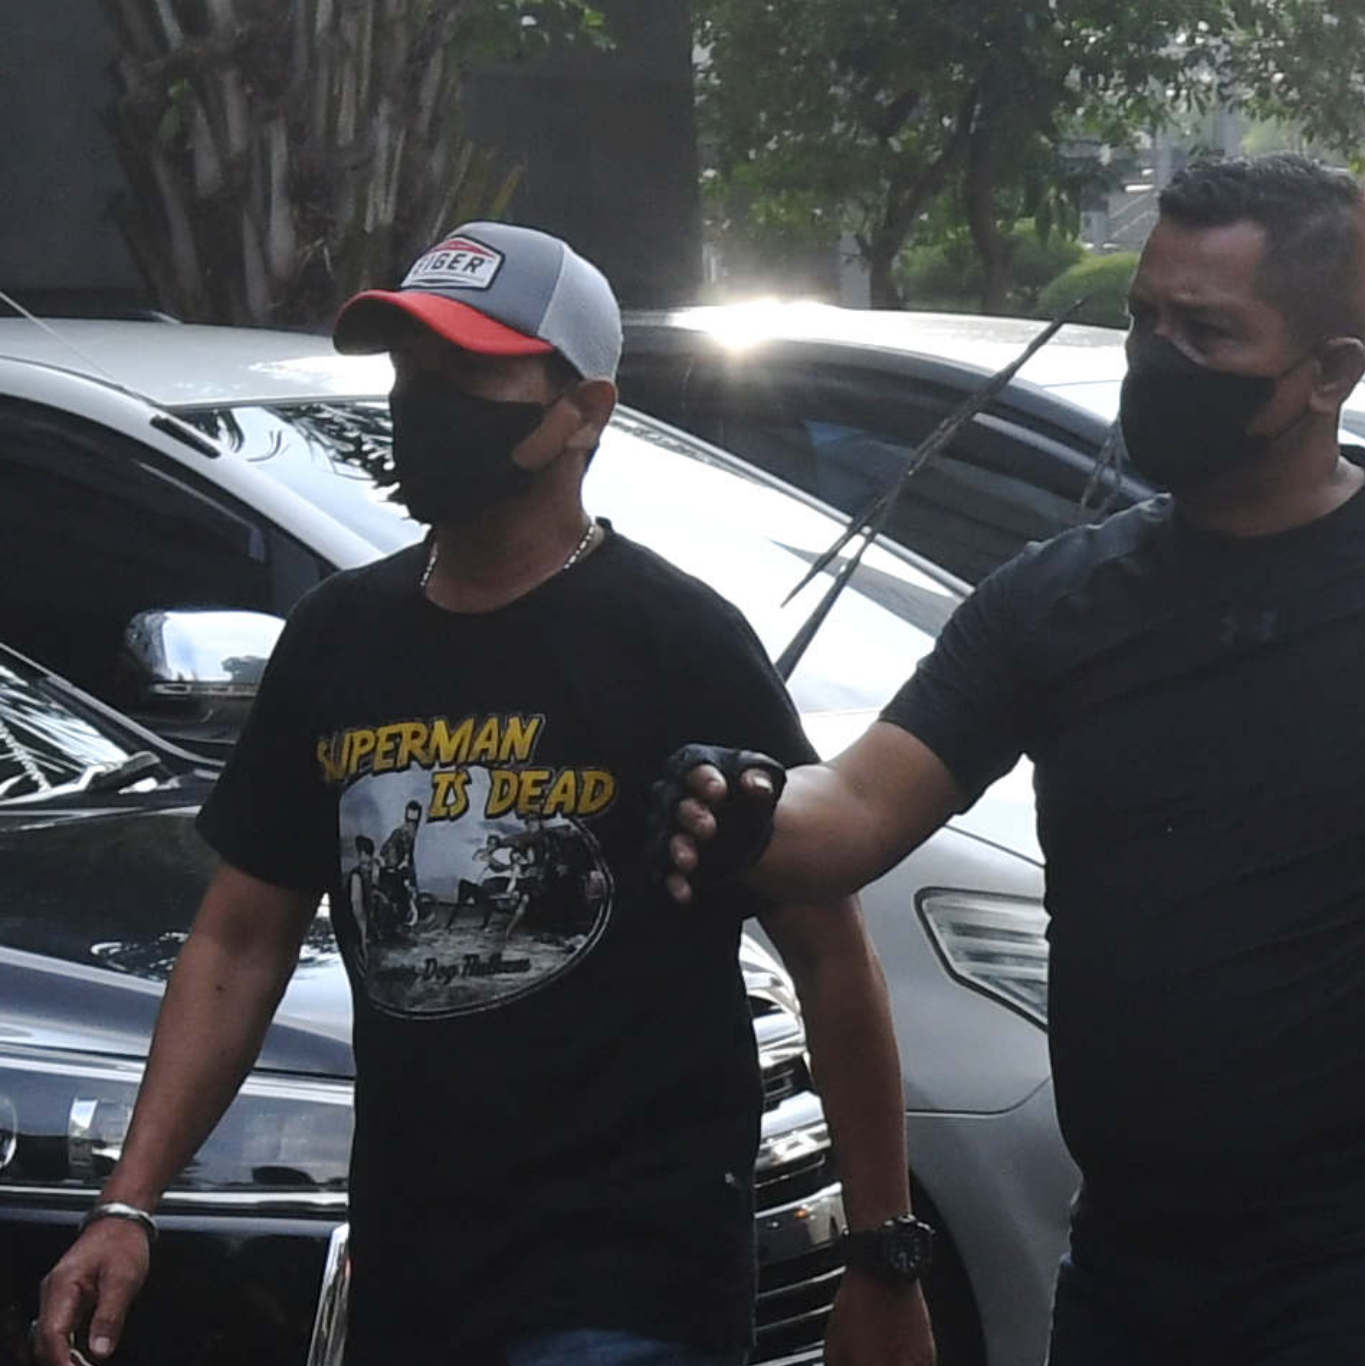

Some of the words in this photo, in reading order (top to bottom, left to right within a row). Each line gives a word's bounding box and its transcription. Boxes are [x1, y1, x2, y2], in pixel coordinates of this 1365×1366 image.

[316, 714, 543, 783] SUPERMAN
[429, 769, 470, 820] IS
[487, 768, 615, 817] DEAD
